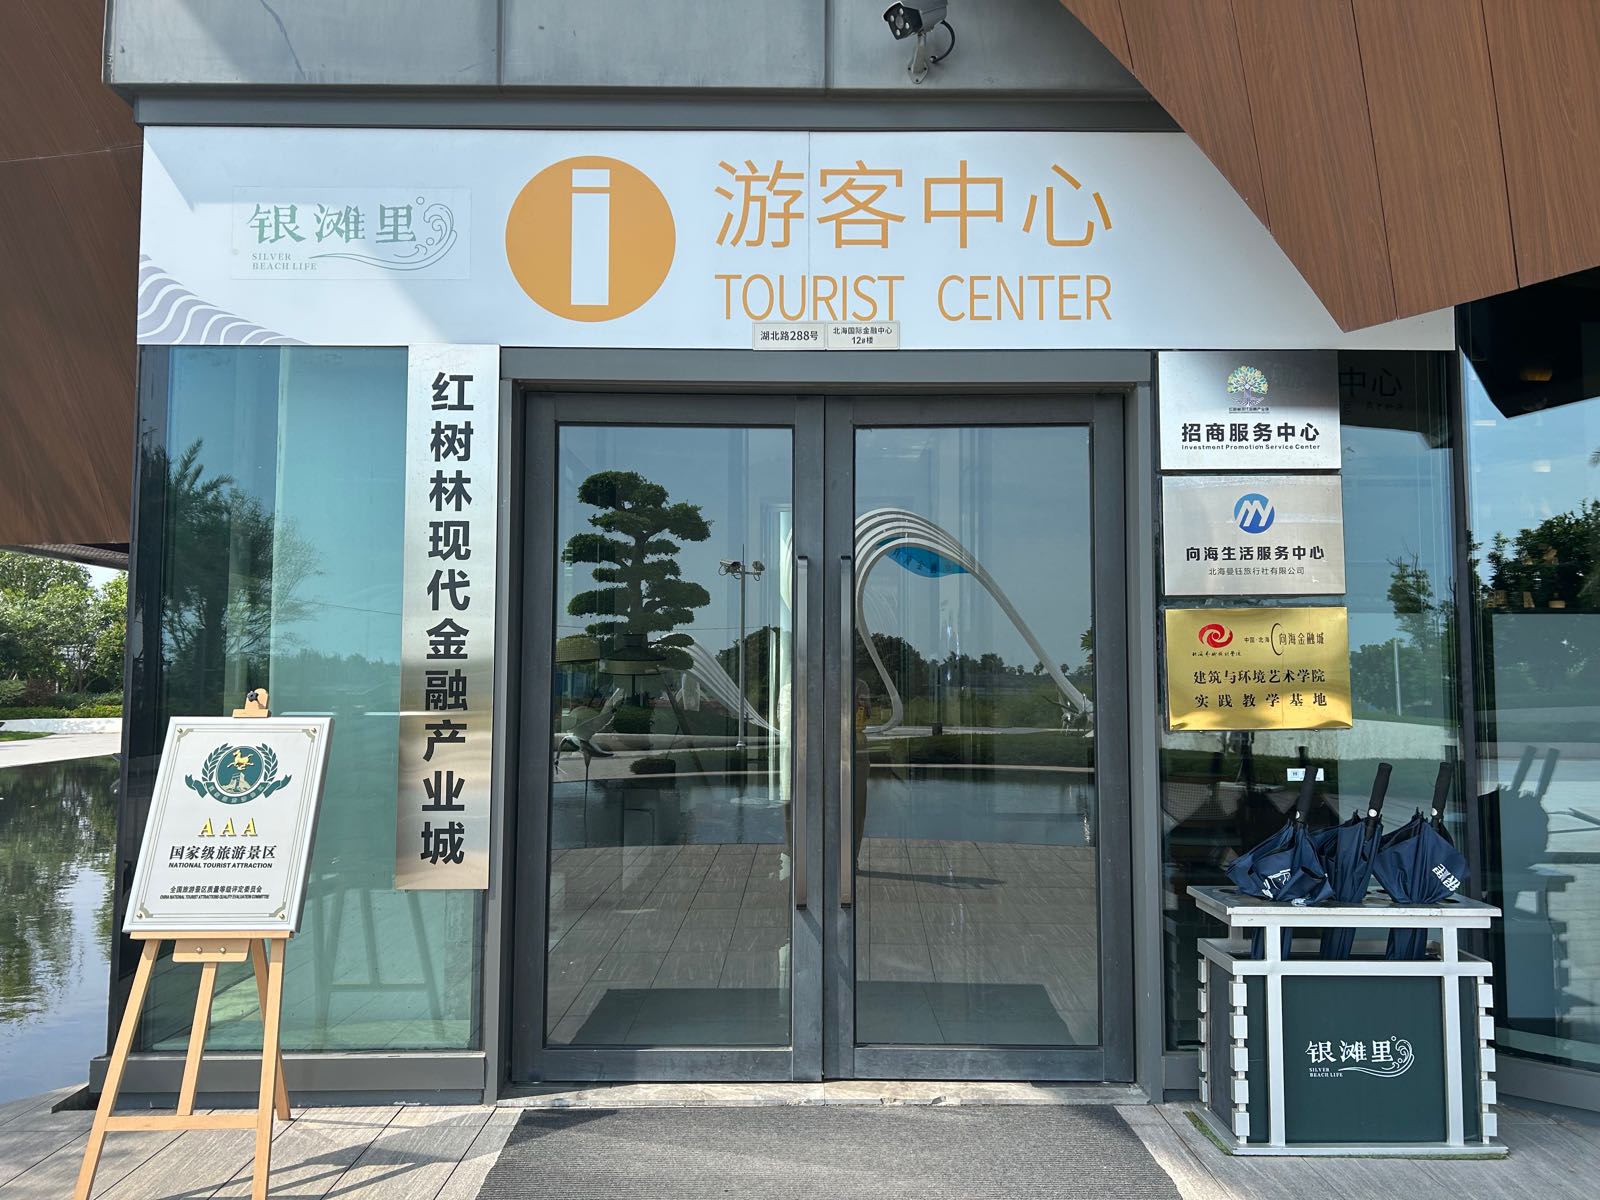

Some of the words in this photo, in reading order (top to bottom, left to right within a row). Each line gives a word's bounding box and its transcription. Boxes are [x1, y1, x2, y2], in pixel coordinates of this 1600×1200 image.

[714, 159, 1113, 249] 游客中心
[247, 203, 416, 244] 银滩里
[252, 253, 291, 261] SILVER
[252, 262, 289, 271] BEACH
[292, 262, 317, 271] LIFE
[715, 274, 905, 322] TOURIST
[937, 274, 1113, 322] CENTER
[760, 330, 819, 341] 湖北路288号
[833, 326, 893, 335] 北海国际金融中心
[1181, 422, 1320, 443] 招商服务中心
[1186, 545, 1325, 562] 向海生活服务中心
[1208, 567, 1305, 576] 北海曼钰旅行社有限公司
[420, 371, 475, 867] 红树林现代金融产业城
[1278, 632, 1325, 646] 向海金融城
[1193, 669, 1326, 685] 建筑与环境艺术学院
[1194, 692, 1328, 708] 实践教学基地
[169, 845, 277, 860] 国家级旅游景区
[1305, 1040, 1394, 1063] 银滩里
